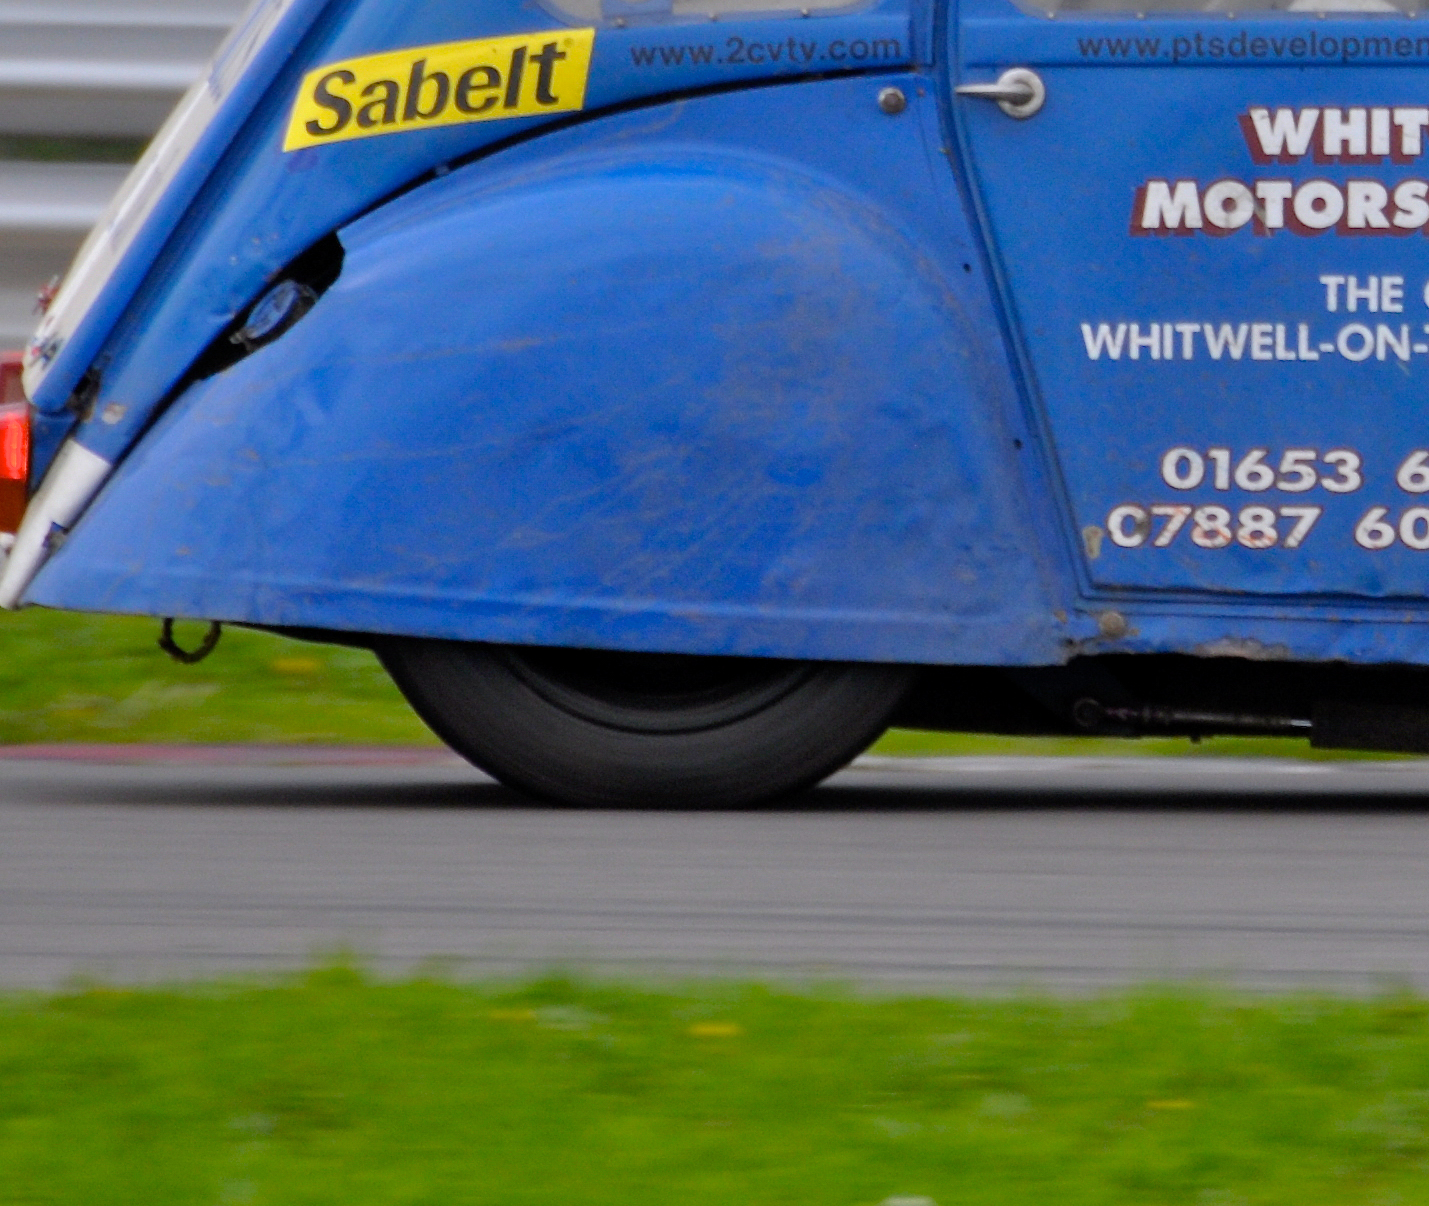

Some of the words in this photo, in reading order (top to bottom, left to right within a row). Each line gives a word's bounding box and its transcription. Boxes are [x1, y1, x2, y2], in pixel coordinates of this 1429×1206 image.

[630, 35, 902, 69] www.2cvtv.com
[305, 42, 569, 137] Sabelt
[1320, 275, 1403, 313] THE
[1160, 446, 1363, 494] 01653
